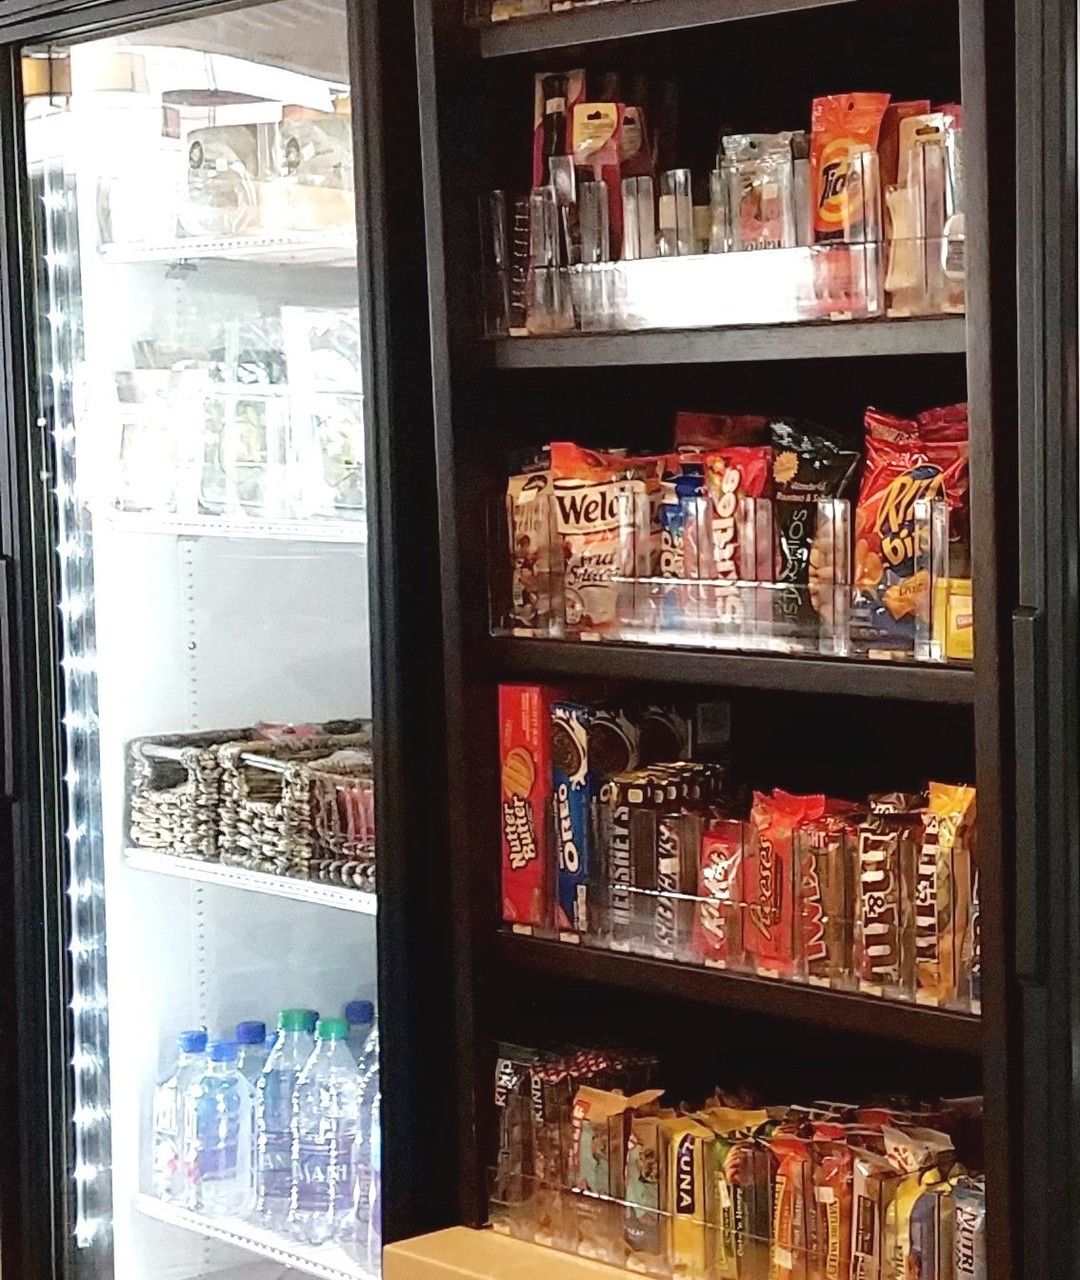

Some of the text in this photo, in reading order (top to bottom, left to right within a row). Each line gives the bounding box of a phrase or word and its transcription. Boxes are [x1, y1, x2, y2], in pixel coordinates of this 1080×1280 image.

[504, 801, 527, 870] Nutter
[512, 795, 537, 861] Butter
[558, 782, 580, 874] OREO
[494, 1059, 514, 1108] KIND
[531, 1075, 545, 1123] KIND
[680, 1134, 695, 1208] LUNA
